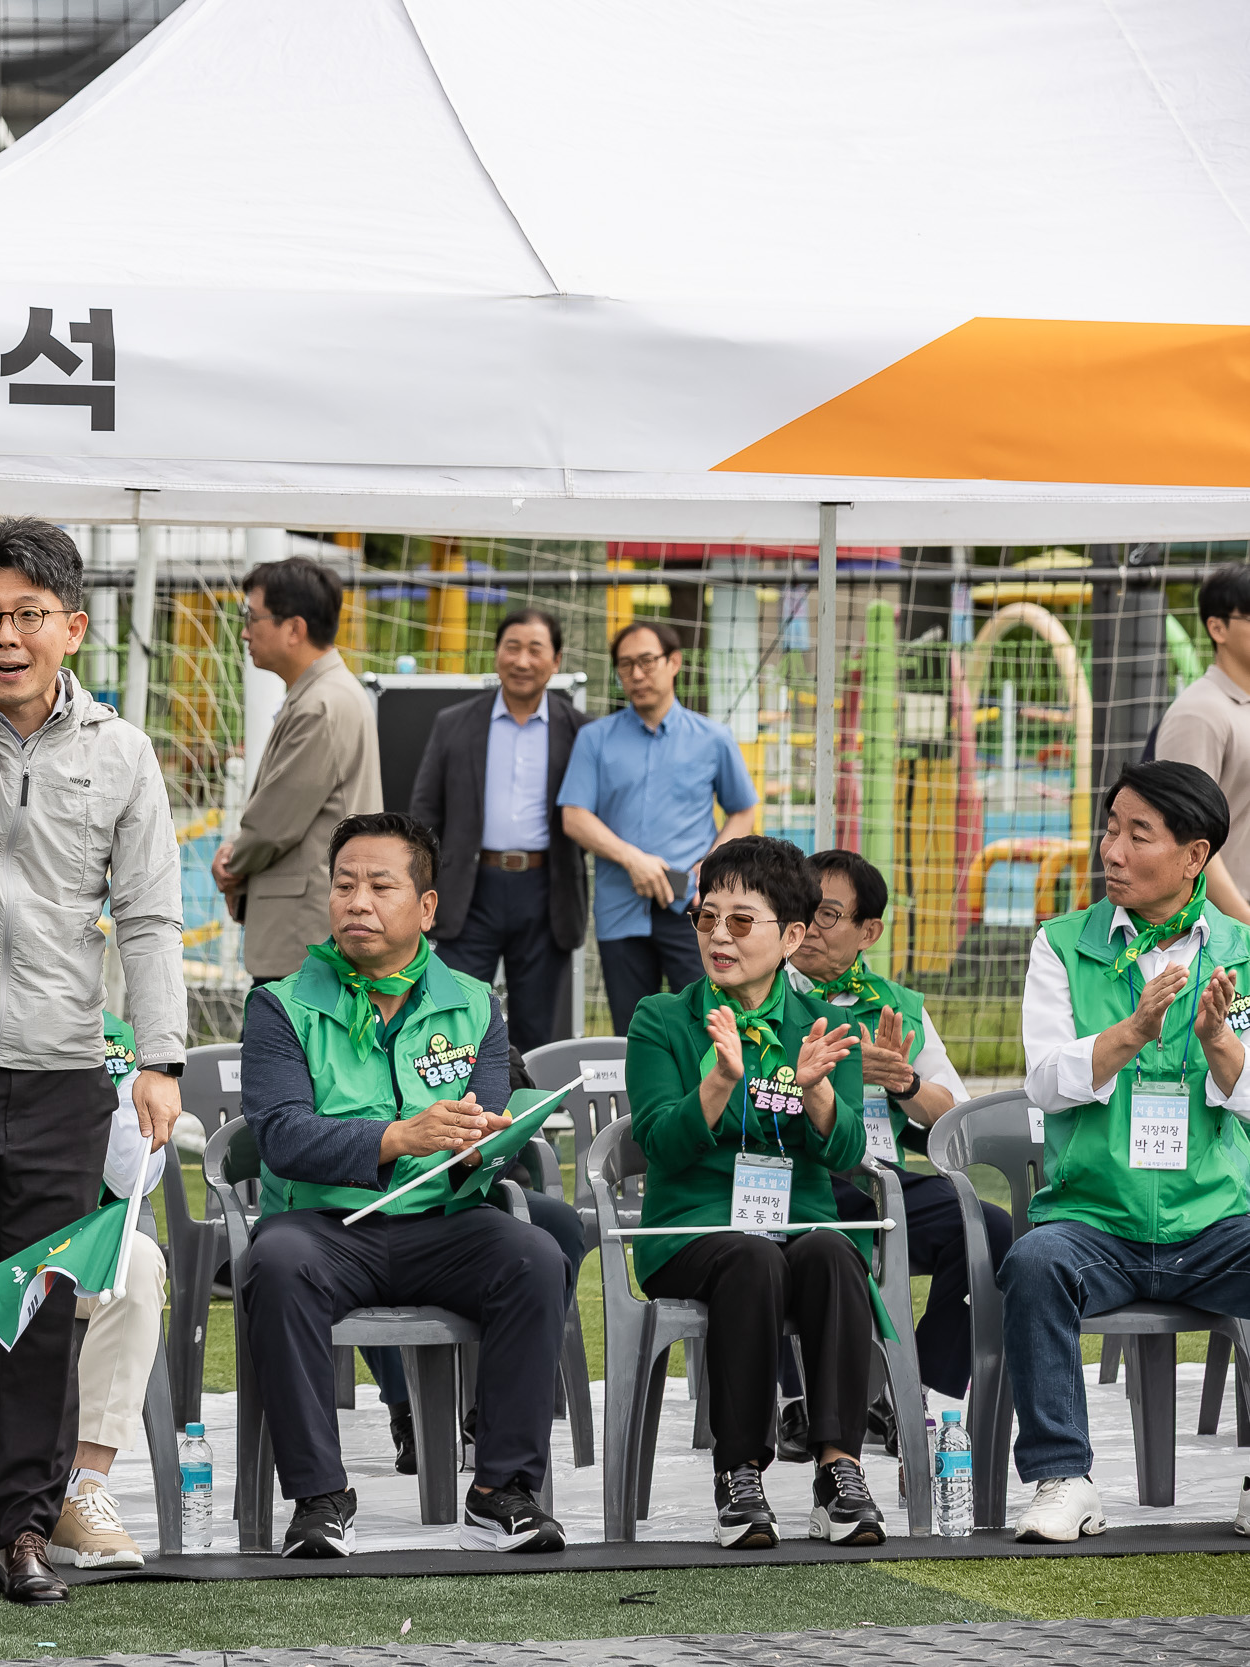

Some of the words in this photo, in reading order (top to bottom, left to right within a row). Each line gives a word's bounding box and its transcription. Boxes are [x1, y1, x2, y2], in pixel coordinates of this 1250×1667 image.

[0, 306, 116, 431] 석
[1135, 1105, 1186, 1118] 서울특별시
[1141, 1124, 1179, 1137] 직장회장
[737, 1174, 789, 1190] 서울특별시
[742, 1194, 781, 1209] 부녀회장
